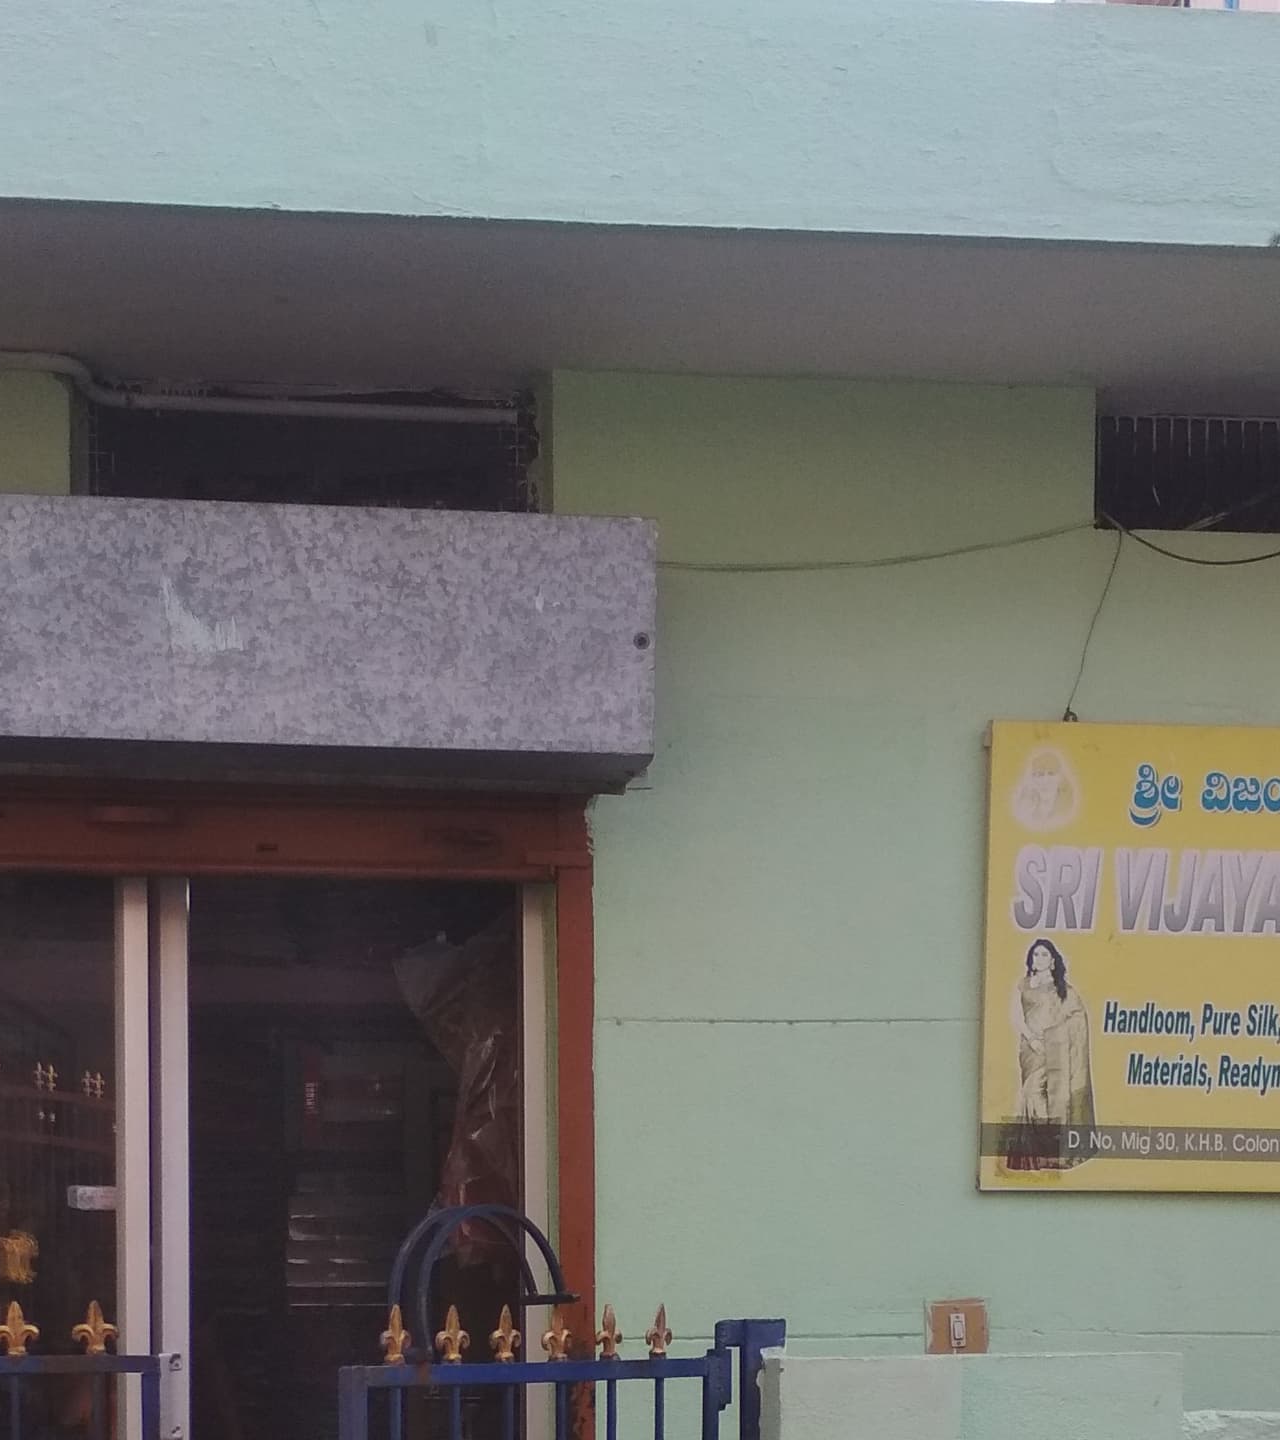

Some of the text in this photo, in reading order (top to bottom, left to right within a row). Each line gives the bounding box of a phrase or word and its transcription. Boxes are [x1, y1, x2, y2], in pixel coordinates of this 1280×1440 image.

[1128, 763, 1183, 827] ಶ್ರೀ
[1013, 847, 1103, 931] SRI
[1102, 1001, 1196, 1042] Handloom,
[1200, 1003, 1241, 1036] Pure
[1126, 1053, 1213, 1093] Materials,
[1121, 1132, 1151, 1154] Mig
[1155, 1132, 1179, 1153] 30,
[1184, 1133, 1227, 1152] K.H.B.
